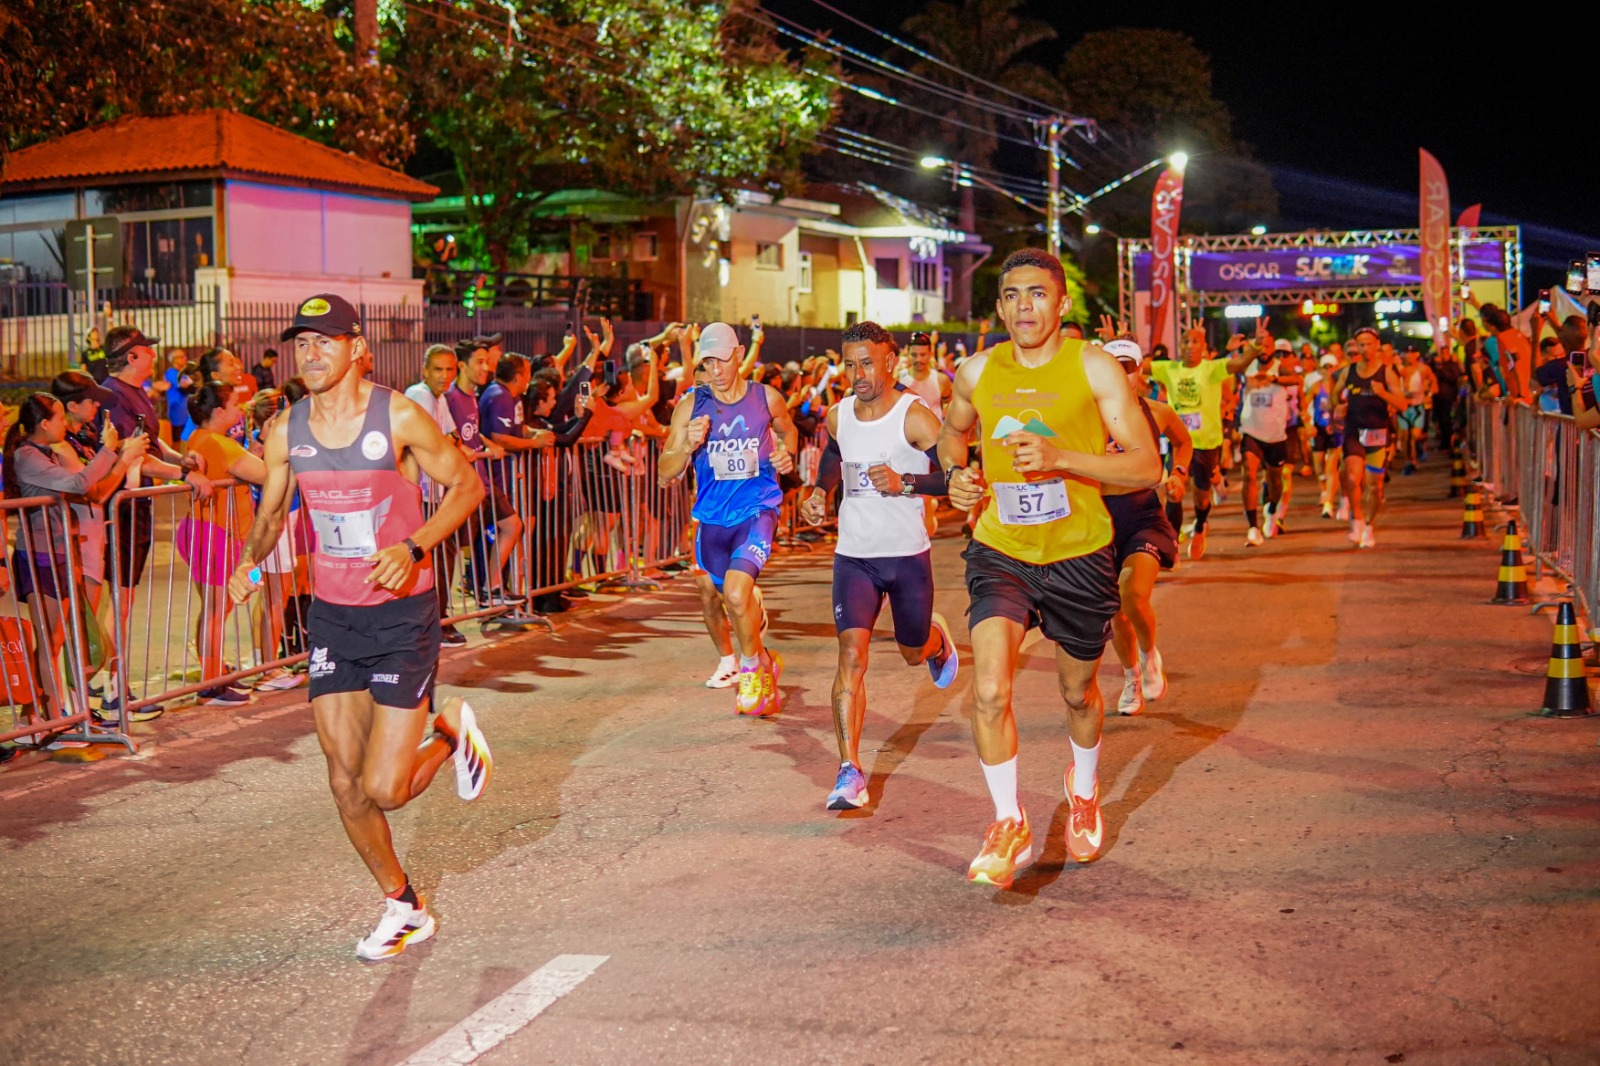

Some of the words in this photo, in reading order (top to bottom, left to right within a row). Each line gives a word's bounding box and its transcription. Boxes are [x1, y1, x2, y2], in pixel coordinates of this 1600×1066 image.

[1152, 187, 1184, 308] OSCAR
[1219, 262, 1280, 280] OSCAR
[707, 437, 760, 453] move
[727, 458, 746, 472] 80
[307, 488, 372, 500] EAGLES
[1018, 492, 1044, 513] 57
[334, 525, 343, 546] 1
